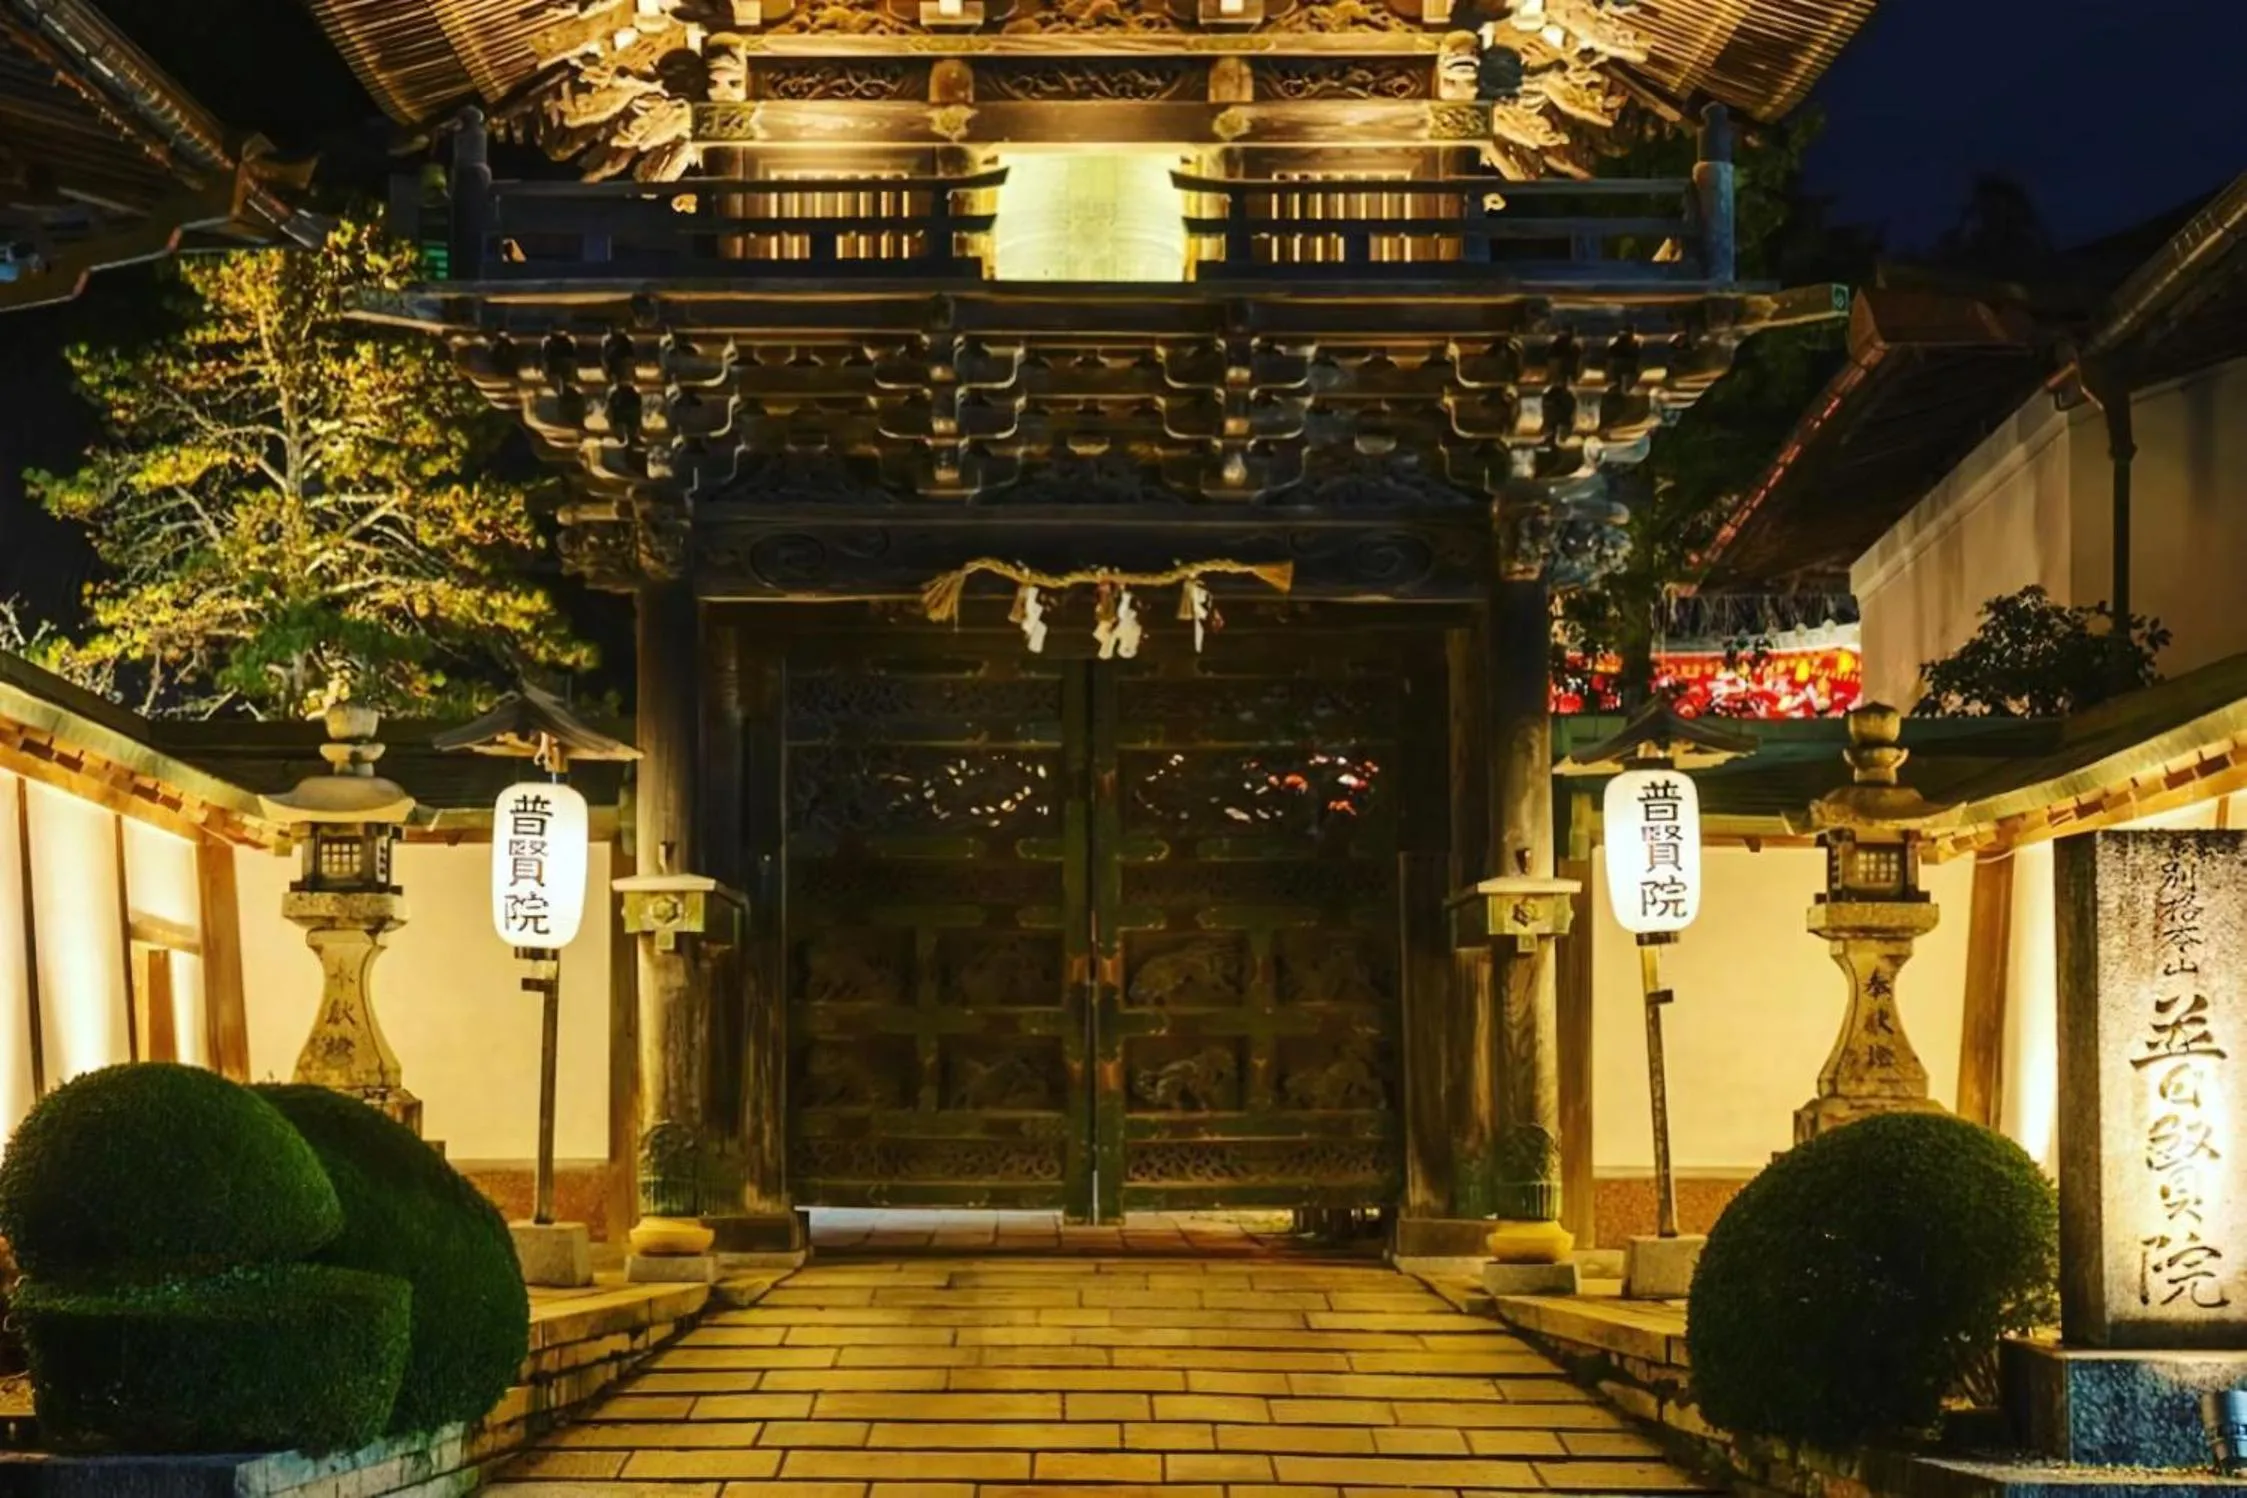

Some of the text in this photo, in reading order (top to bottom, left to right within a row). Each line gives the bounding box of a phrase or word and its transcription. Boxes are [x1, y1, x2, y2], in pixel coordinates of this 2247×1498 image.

[503, 794, 553, 935] 普賢院
[1637, 779, 1688, 918] 普賢院
